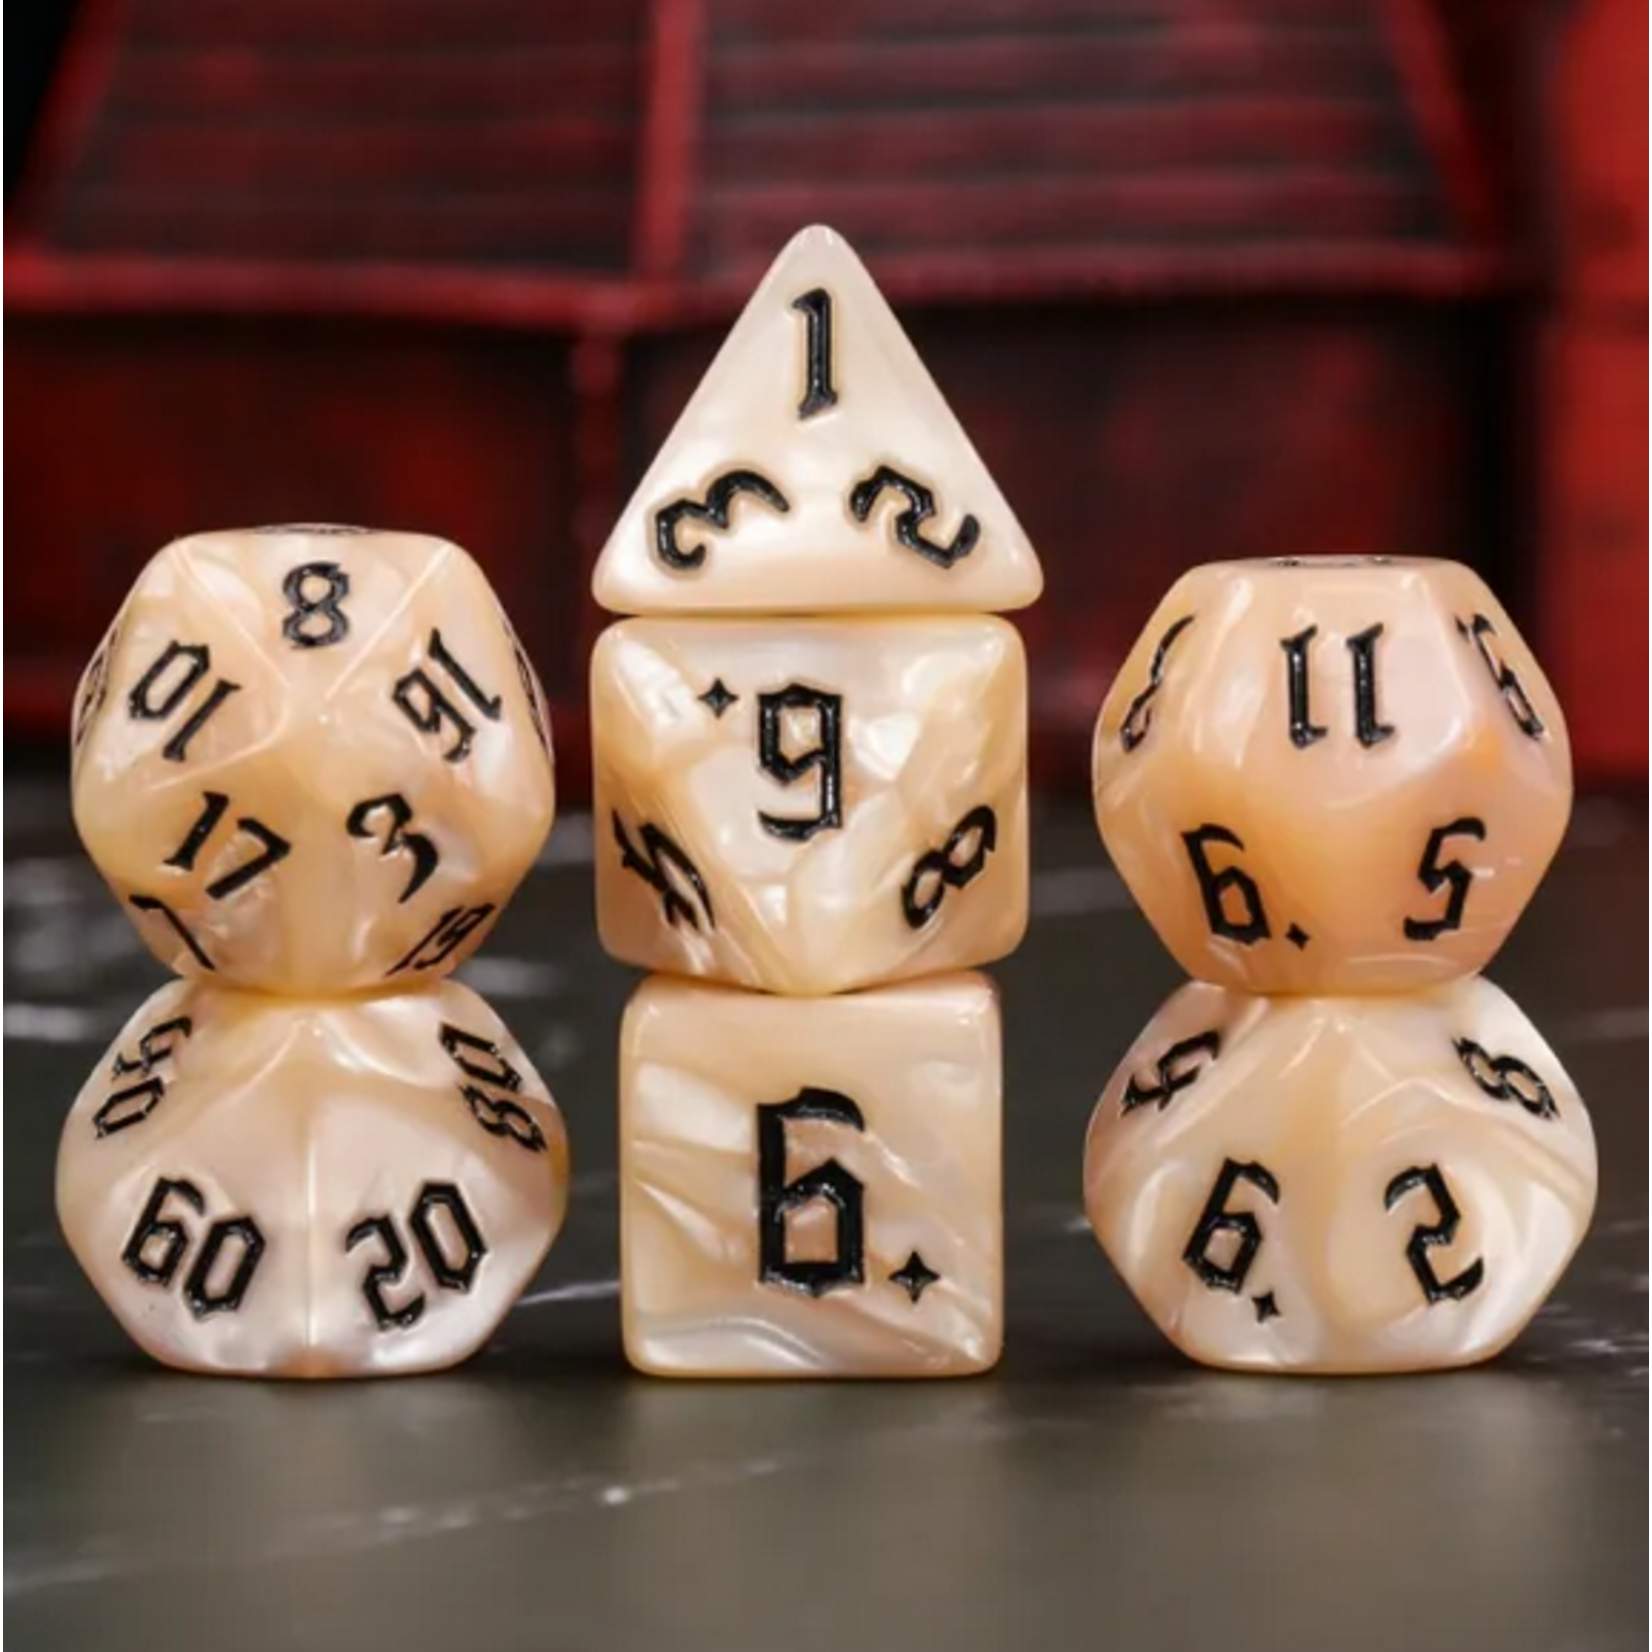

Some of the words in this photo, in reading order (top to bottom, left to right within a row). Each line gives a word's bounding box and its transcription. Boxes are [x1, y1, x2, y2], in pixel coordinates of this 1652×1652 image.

[793, 286, 839, 418] 1
[653, 469, 790, 570] 3
[850, 465, 983, 570] 2
[282, 561, 349, 650] 8
[128, 639, 242, 763] 10
[392, 627, 502, 764] 16
[1280, 624, 1394, 750] 11
[162, 791, 292, 900] 17
[345, 792, 439, 905] 3
[900, 803, 998, 931] 8
[1402, 816, 1487, 942] 5
[128, 894, 217, 973] 7
[1452, 1035, 1560, 1122] 8
[120, 1176, 268, 1325] 60
[344, 1179, 489, 1334] 20
[1382, 1161, 1485, 1310] 2
